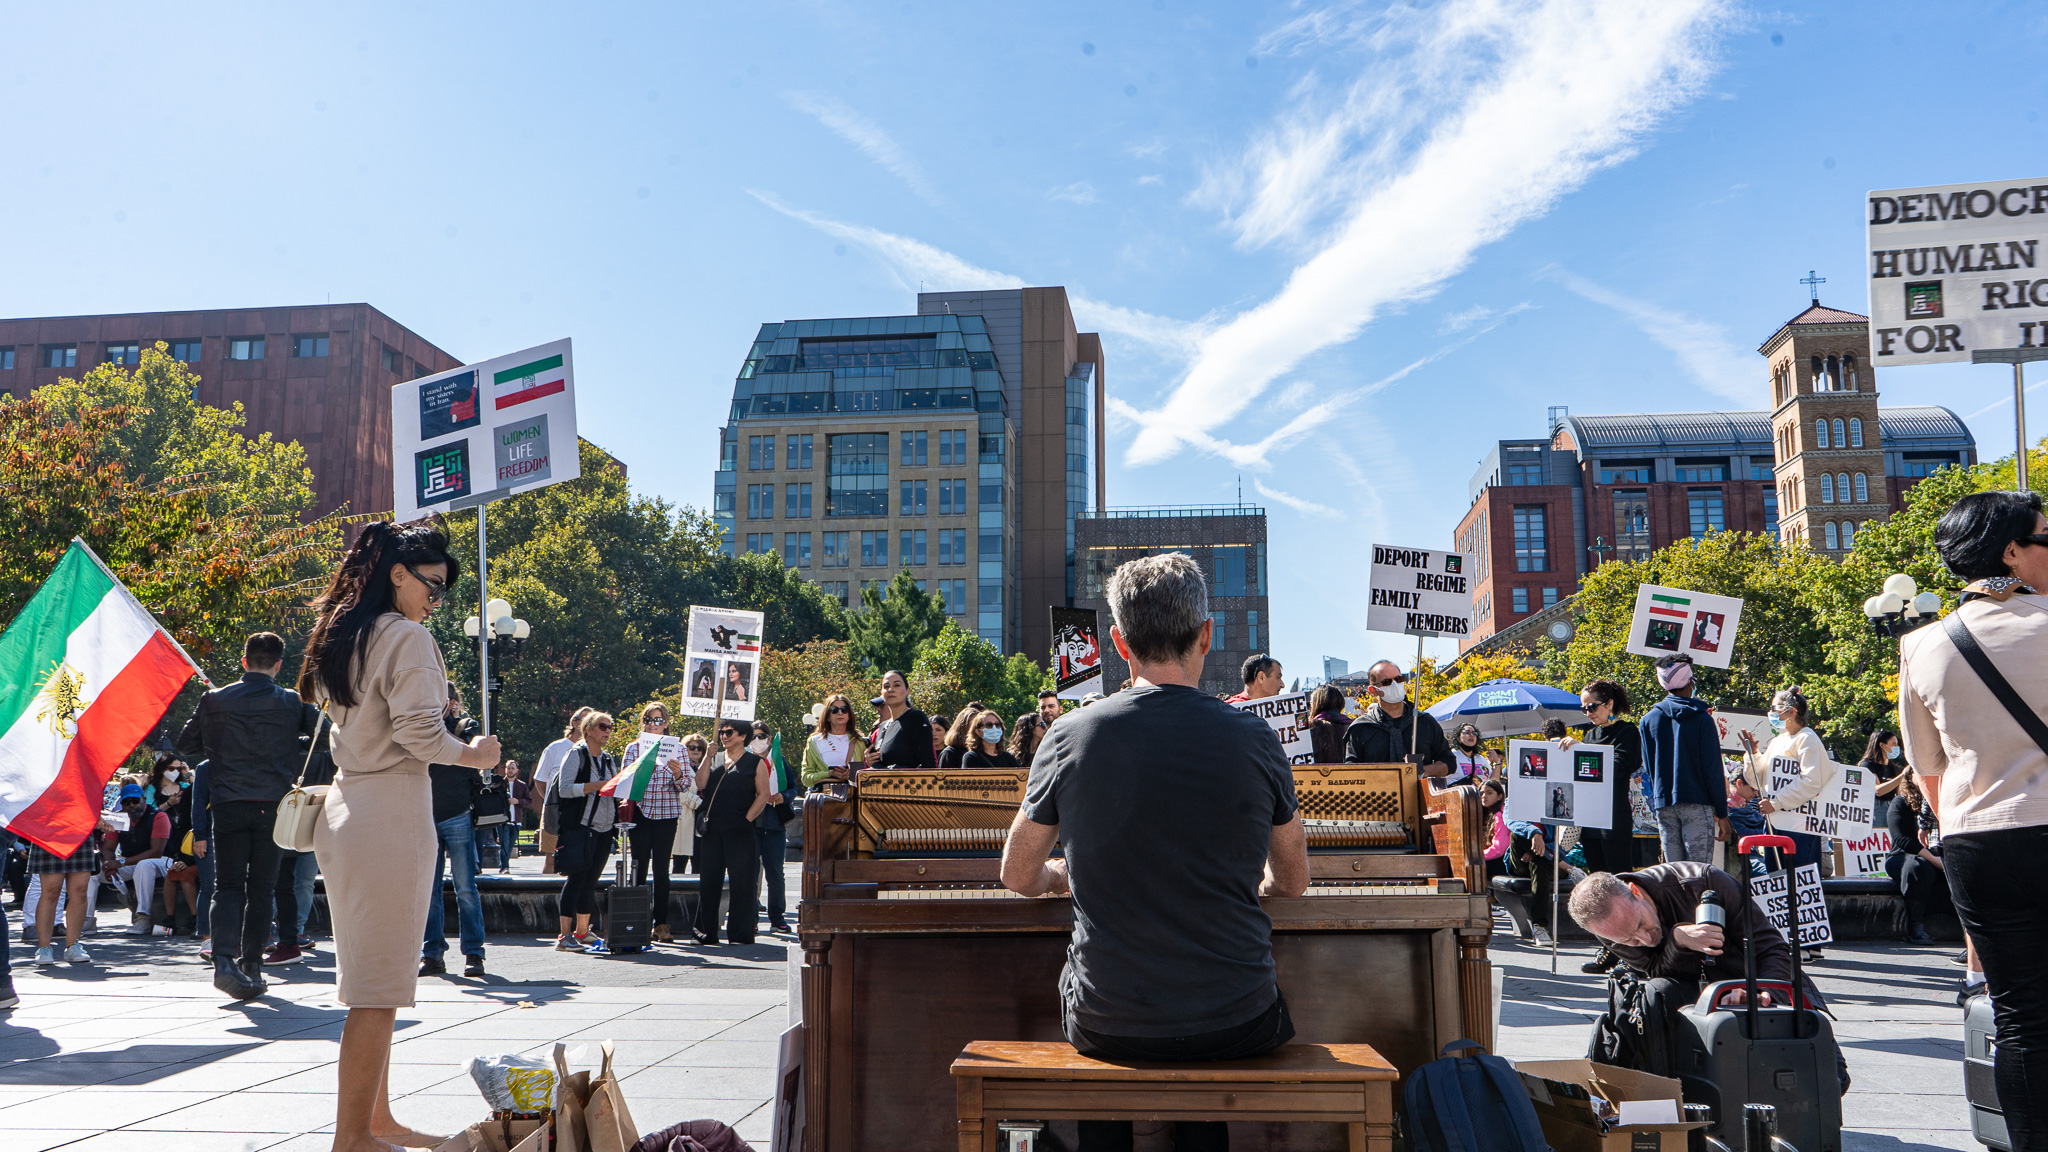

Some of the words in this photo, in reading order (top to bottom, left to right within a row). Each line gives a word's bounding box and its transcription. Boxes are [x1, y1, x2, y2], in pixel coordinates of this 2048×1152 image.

[1872, 239, 2039, 279] HUMAN
[1876, 323, 1964, 356] FOR
[2018, 320, 2048, 348] I
[426, 385, 442, 395] stand
[443, 382, 457, 391] with
[437, 390, 454, 398] sisters
[502, 424, 541, 446] WOMEN
[509, 441, 533, 461] LIFE
[498, 455, 548, 480] FREEDOM
[1374, 547, 1430, 569] DEPORT
[1416, 572, 1467, 594] REGIME
[1371, 588, 1421, 610] FAMILY
[1406, 612, 1468, 635] MEMBERS
[1477, 688, 1518, 700] TOMMY
[1479, 697, 1519, 708] BAHAMA
[1841, 787, 1859, 804] OF
[1825, 802, 1870, 824] INSIDE
[1805, 815, 1839, 836] IRAN
[1857, 853, 1890, 873] LIF
[1796, 869, 1817, 888] IN
